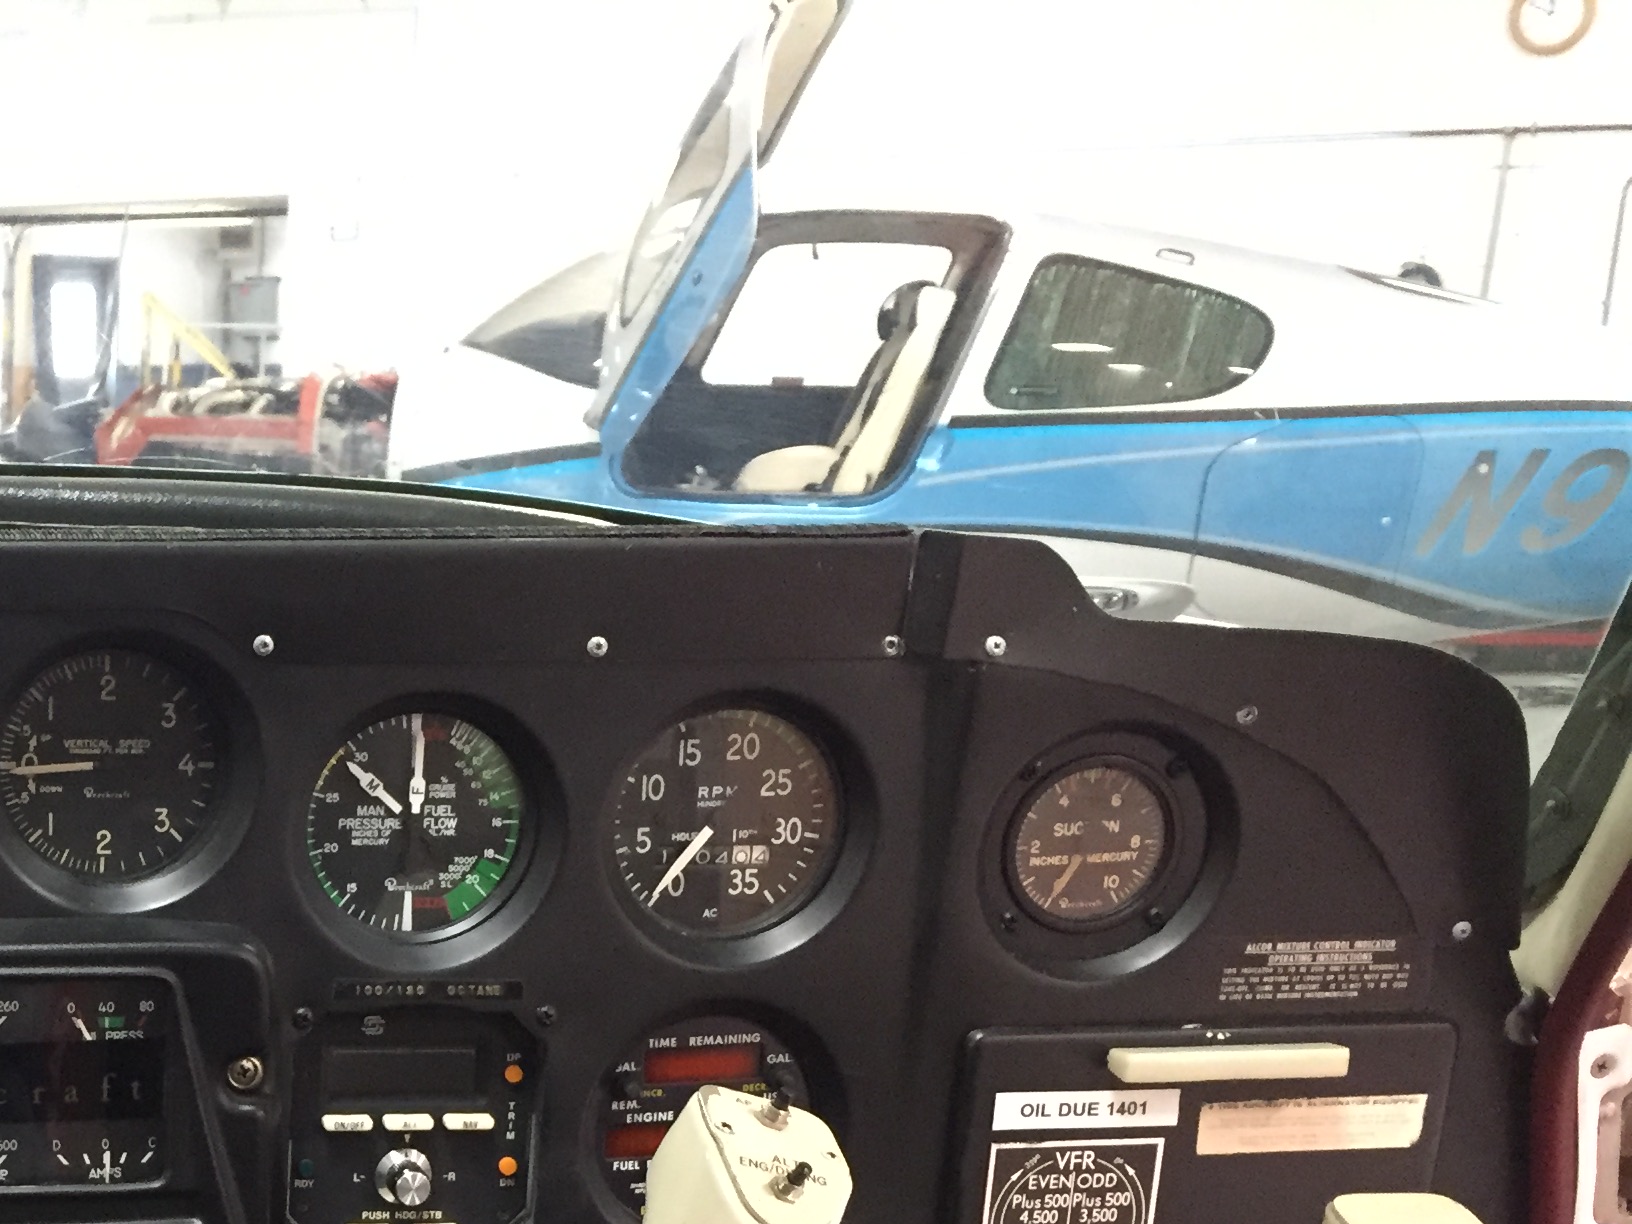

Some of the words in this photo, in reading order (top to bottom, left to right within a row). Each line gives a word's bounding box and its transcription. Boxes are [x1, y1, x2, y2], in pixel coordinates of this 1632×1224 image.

[118, 739, 151, 749] SPEED
[726, 733, 760, 761] 20
[354, 752, 368, 762] 30
[678, 739, 701, 767] 15
[641, 774, 665, 801] 10
[760, 769, 792, 797] 25
[326, 793, 339, 803] 25
[424, 805, 456, 817] FUEL
[338, 818, 403, 830] PRESSURE
[423, 818, 458, 830] FLOW
[771, 818, 802, 844] 30
[351, 838, 390, 846] MERCURY
[635, 827, 651, 854] 5
[324, 843, 338, 853] 20
[1029, 856, 1068, 866] INCHES
[1087, 851, 1138, 863] MERCURY
[466, 874, 480, 884] 20
[728, 869, 759, 895] 35
[1103, 875, 1120, 888] 10
[347, 883, 357, 893] 15
[702, 909, 718, 918] AC
[447, 985, 502, 996] OCTANE
[98, 1001, 115, 1012] 40
[139, 1001, 155, 1011] 80
[649, 1037, 677, 1049] TIME
[689, 1032, 761, 1047] REMAINING
[1020, 1102, 1051, 1119] OIL
[1058, 1101, 1099, 1117] DUE
[1107, 1100, 1148, 1115] 1401
[626, 1110, 674, 1124] ENGINE
[612, 1160, 640, 1171] FUEL
[1055, 1150, 1096, 1171] VFR
[1028, 1173, 1072, 1190] EVEN
[1077, 1173, 1117, 1188] ODD
[1012, 1193, 1041, 1209] Plus
[1044, 1193, 1069, 1208] 500
[1073, 1192, 1101, 1207] Plus
[1105, 1191, 1130, 1206] 500
[361, 1210, 390, 1220] PUSH
[1079, 1208, 1118, 1224] 3,500
